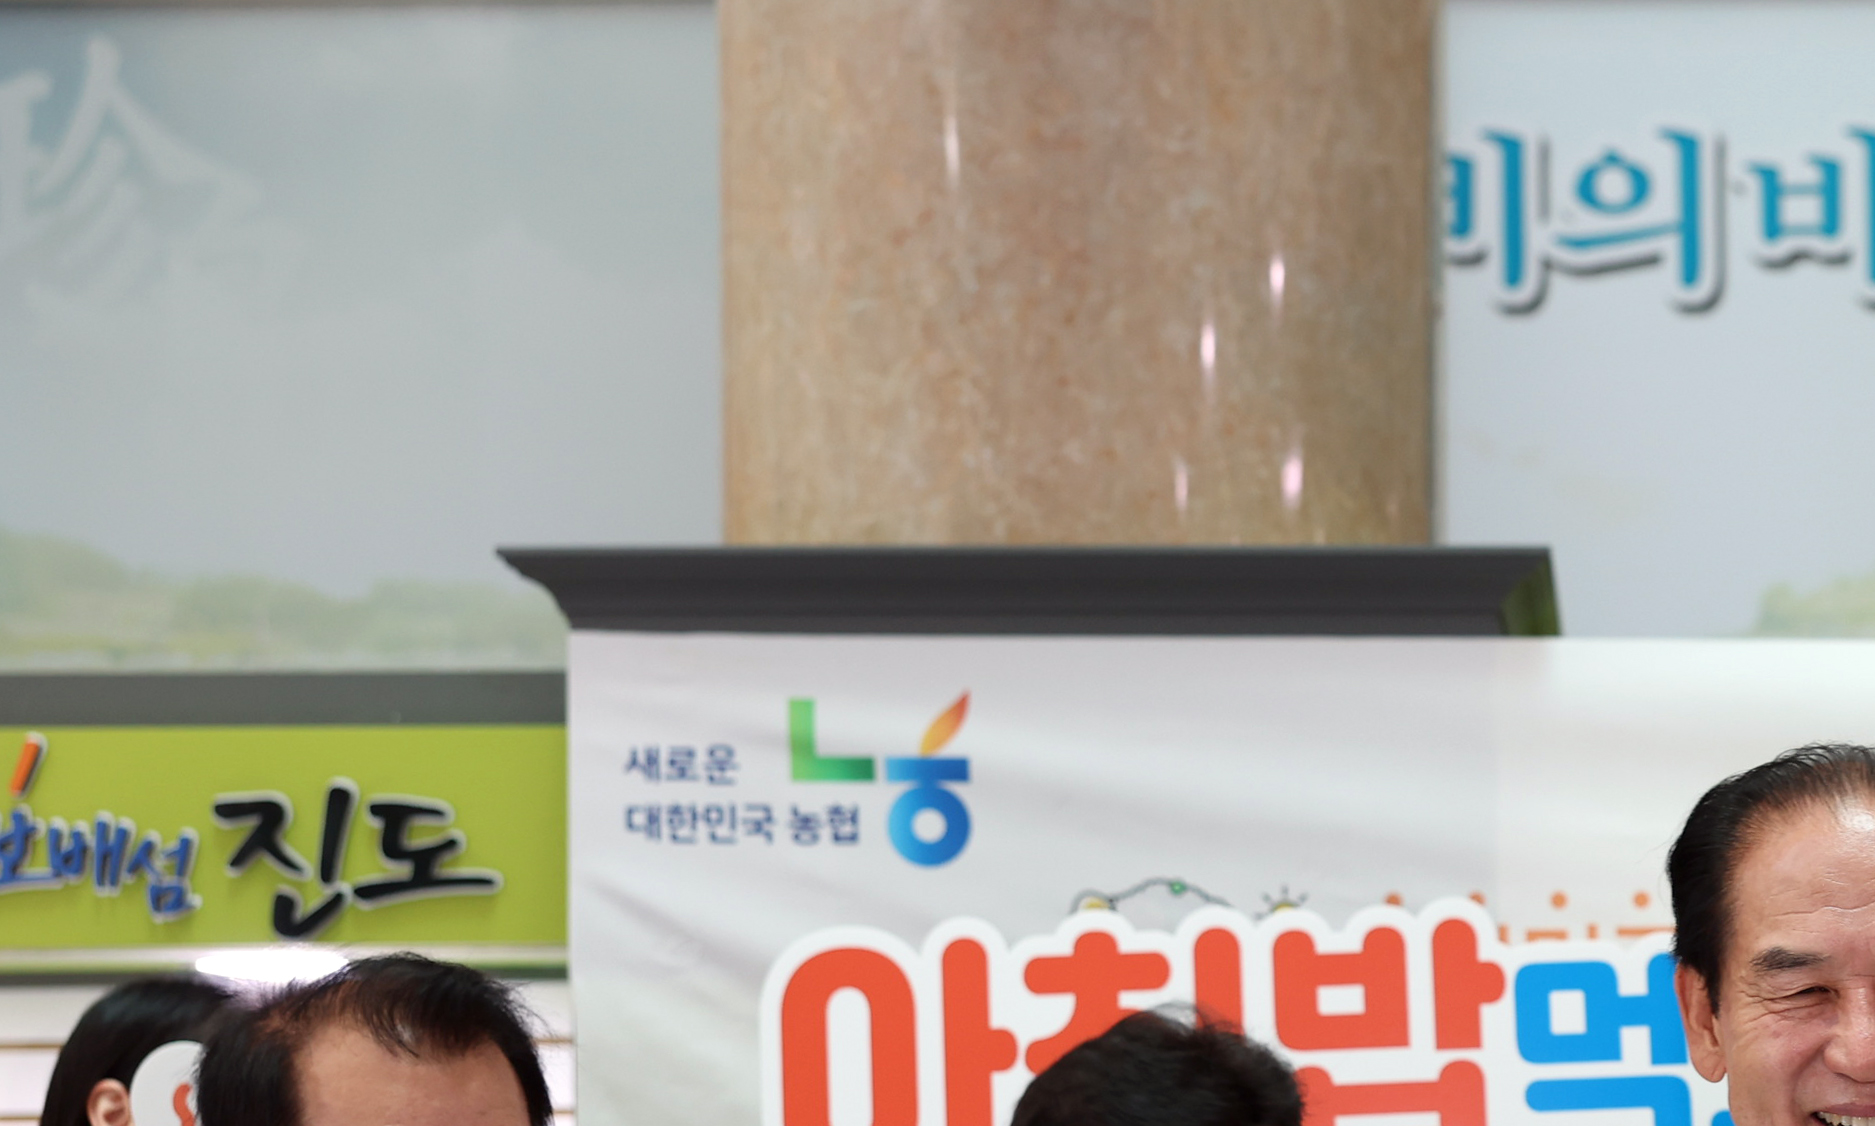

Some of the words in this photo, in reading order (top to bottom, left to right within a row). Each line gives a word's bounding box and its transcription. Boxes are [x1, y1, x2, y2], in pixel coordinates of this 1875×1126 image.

[624, 744, 739, 788] 새로운
[625, 801, 776, 847] 대한민국
[788, 801, 861, 846] 농협
[212, 780, 500, 938] 진도
